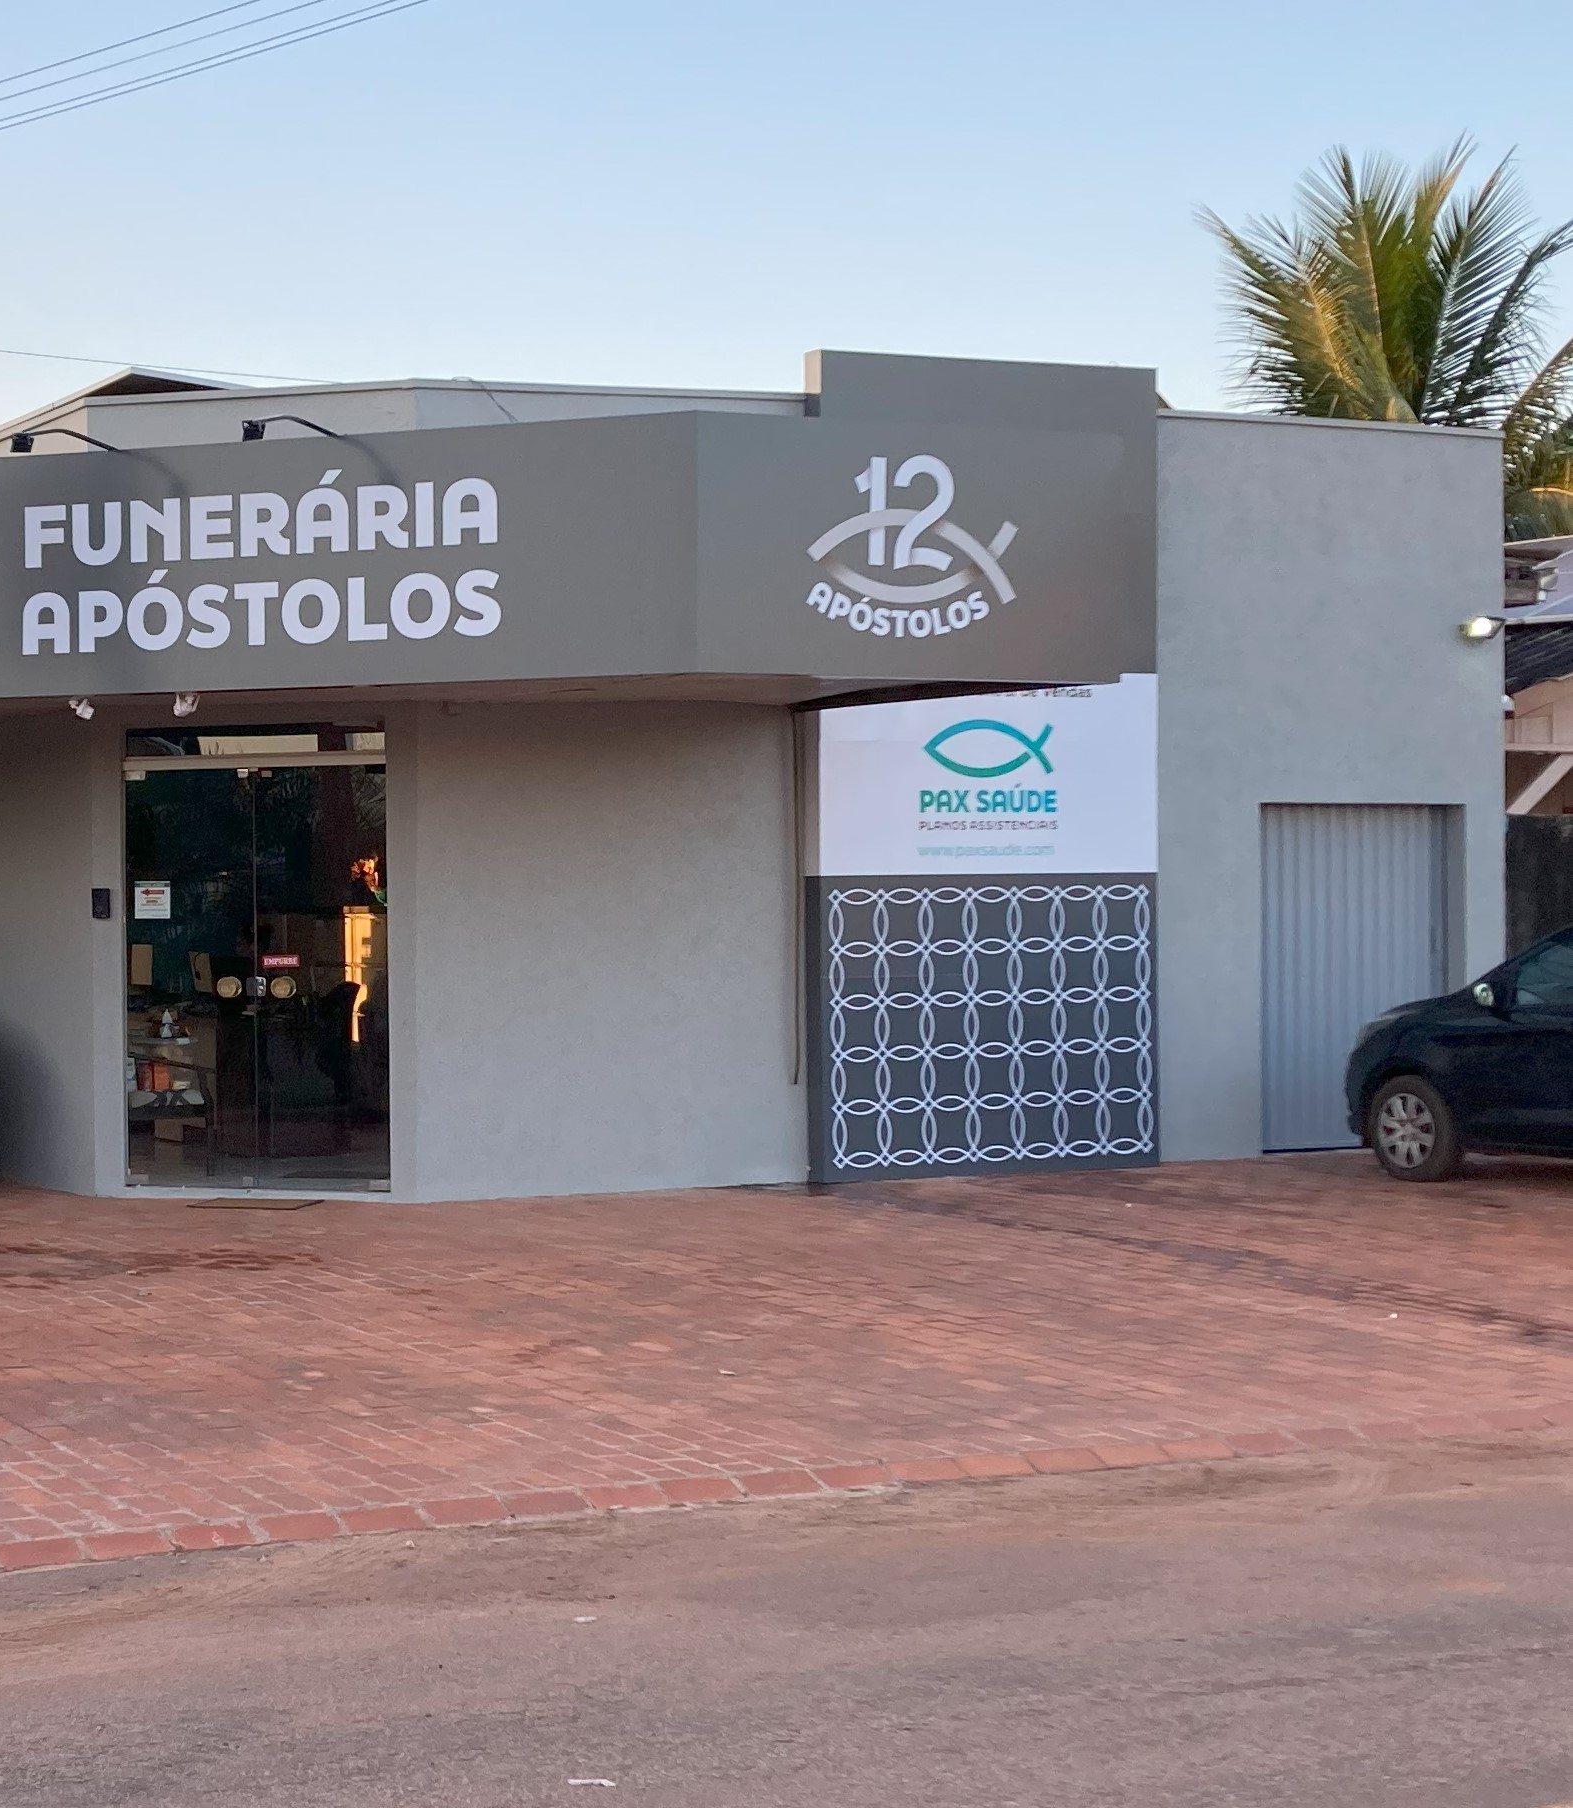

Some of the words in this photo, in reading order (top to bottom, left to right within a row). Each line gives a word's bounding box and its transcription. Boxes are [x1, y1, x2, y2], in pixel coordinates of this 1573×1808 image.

[24, 469, 500, 569] FUNERÁRIA
[854, 454, 955, 571] 12
[22, 569, 502, 656] APÓSTOLOS
[806, 581, 990, 638] APÓSTOLOS
[918, 820, 967, 831] PLANOS
[919, 789, 970, 813] PAX
[976, 783, 1058, 813] SAÚDE
